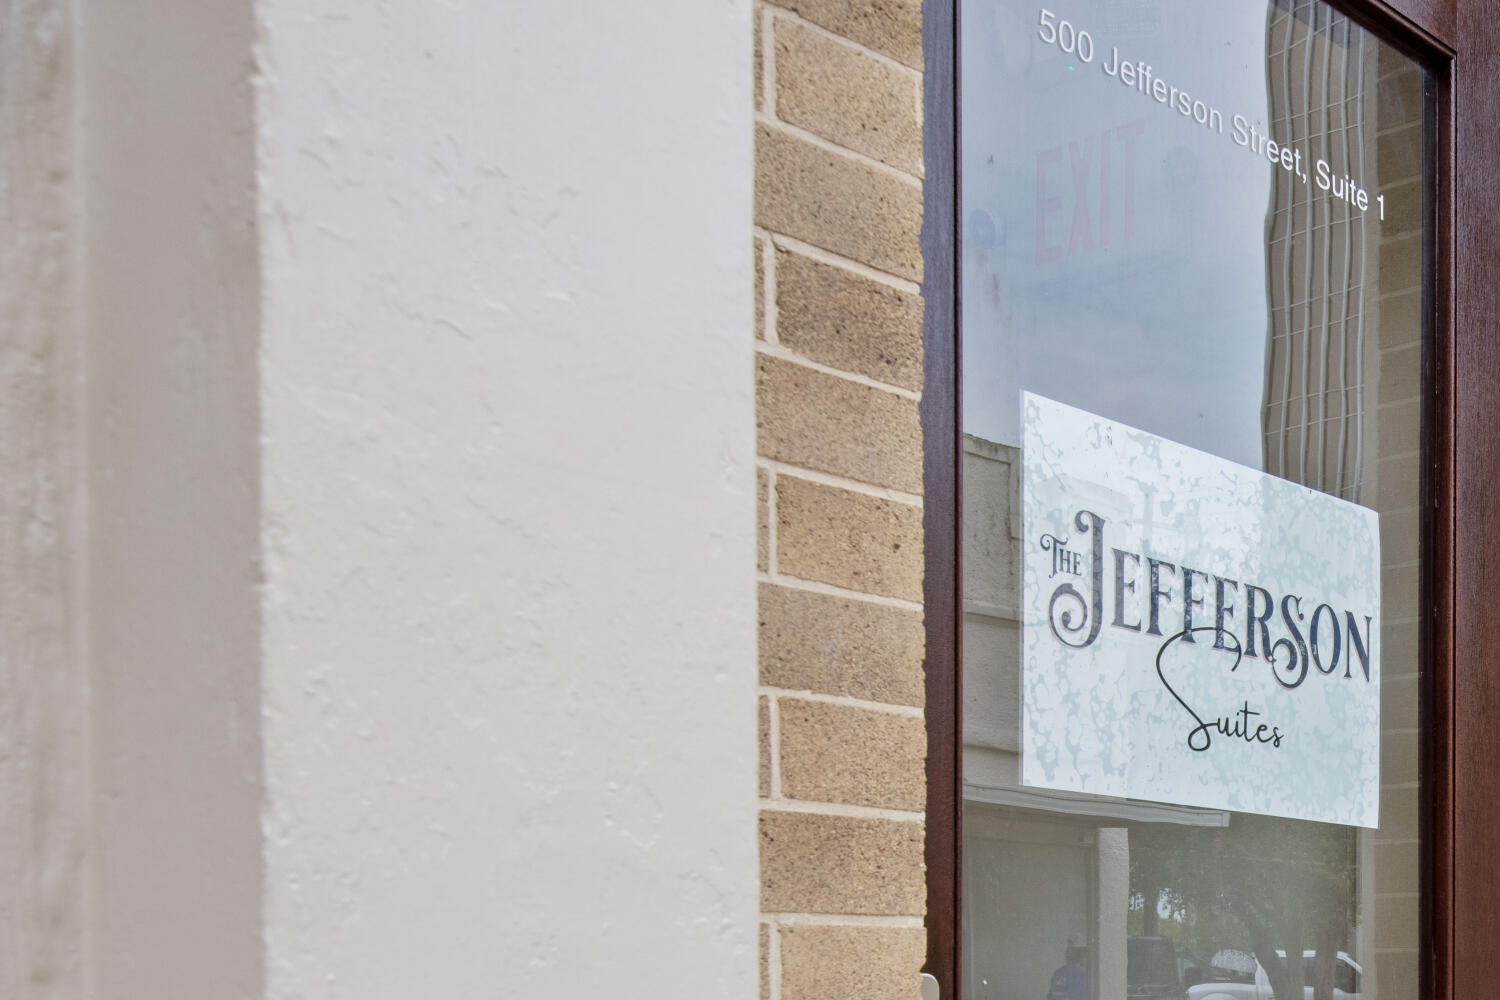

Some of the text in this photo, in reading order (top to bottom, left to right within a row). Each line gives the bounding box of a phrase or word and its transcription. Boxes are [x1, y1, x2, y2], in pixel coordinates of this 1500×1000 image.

[1036, 119, 1146, 265] EXIT
[1039, 9, 1384, 221] 500 Jefferson Street, Suite 1
[1050, 510, 1372, 689] JEFFERSON
[1156, 626, 1284, 751] Suites
